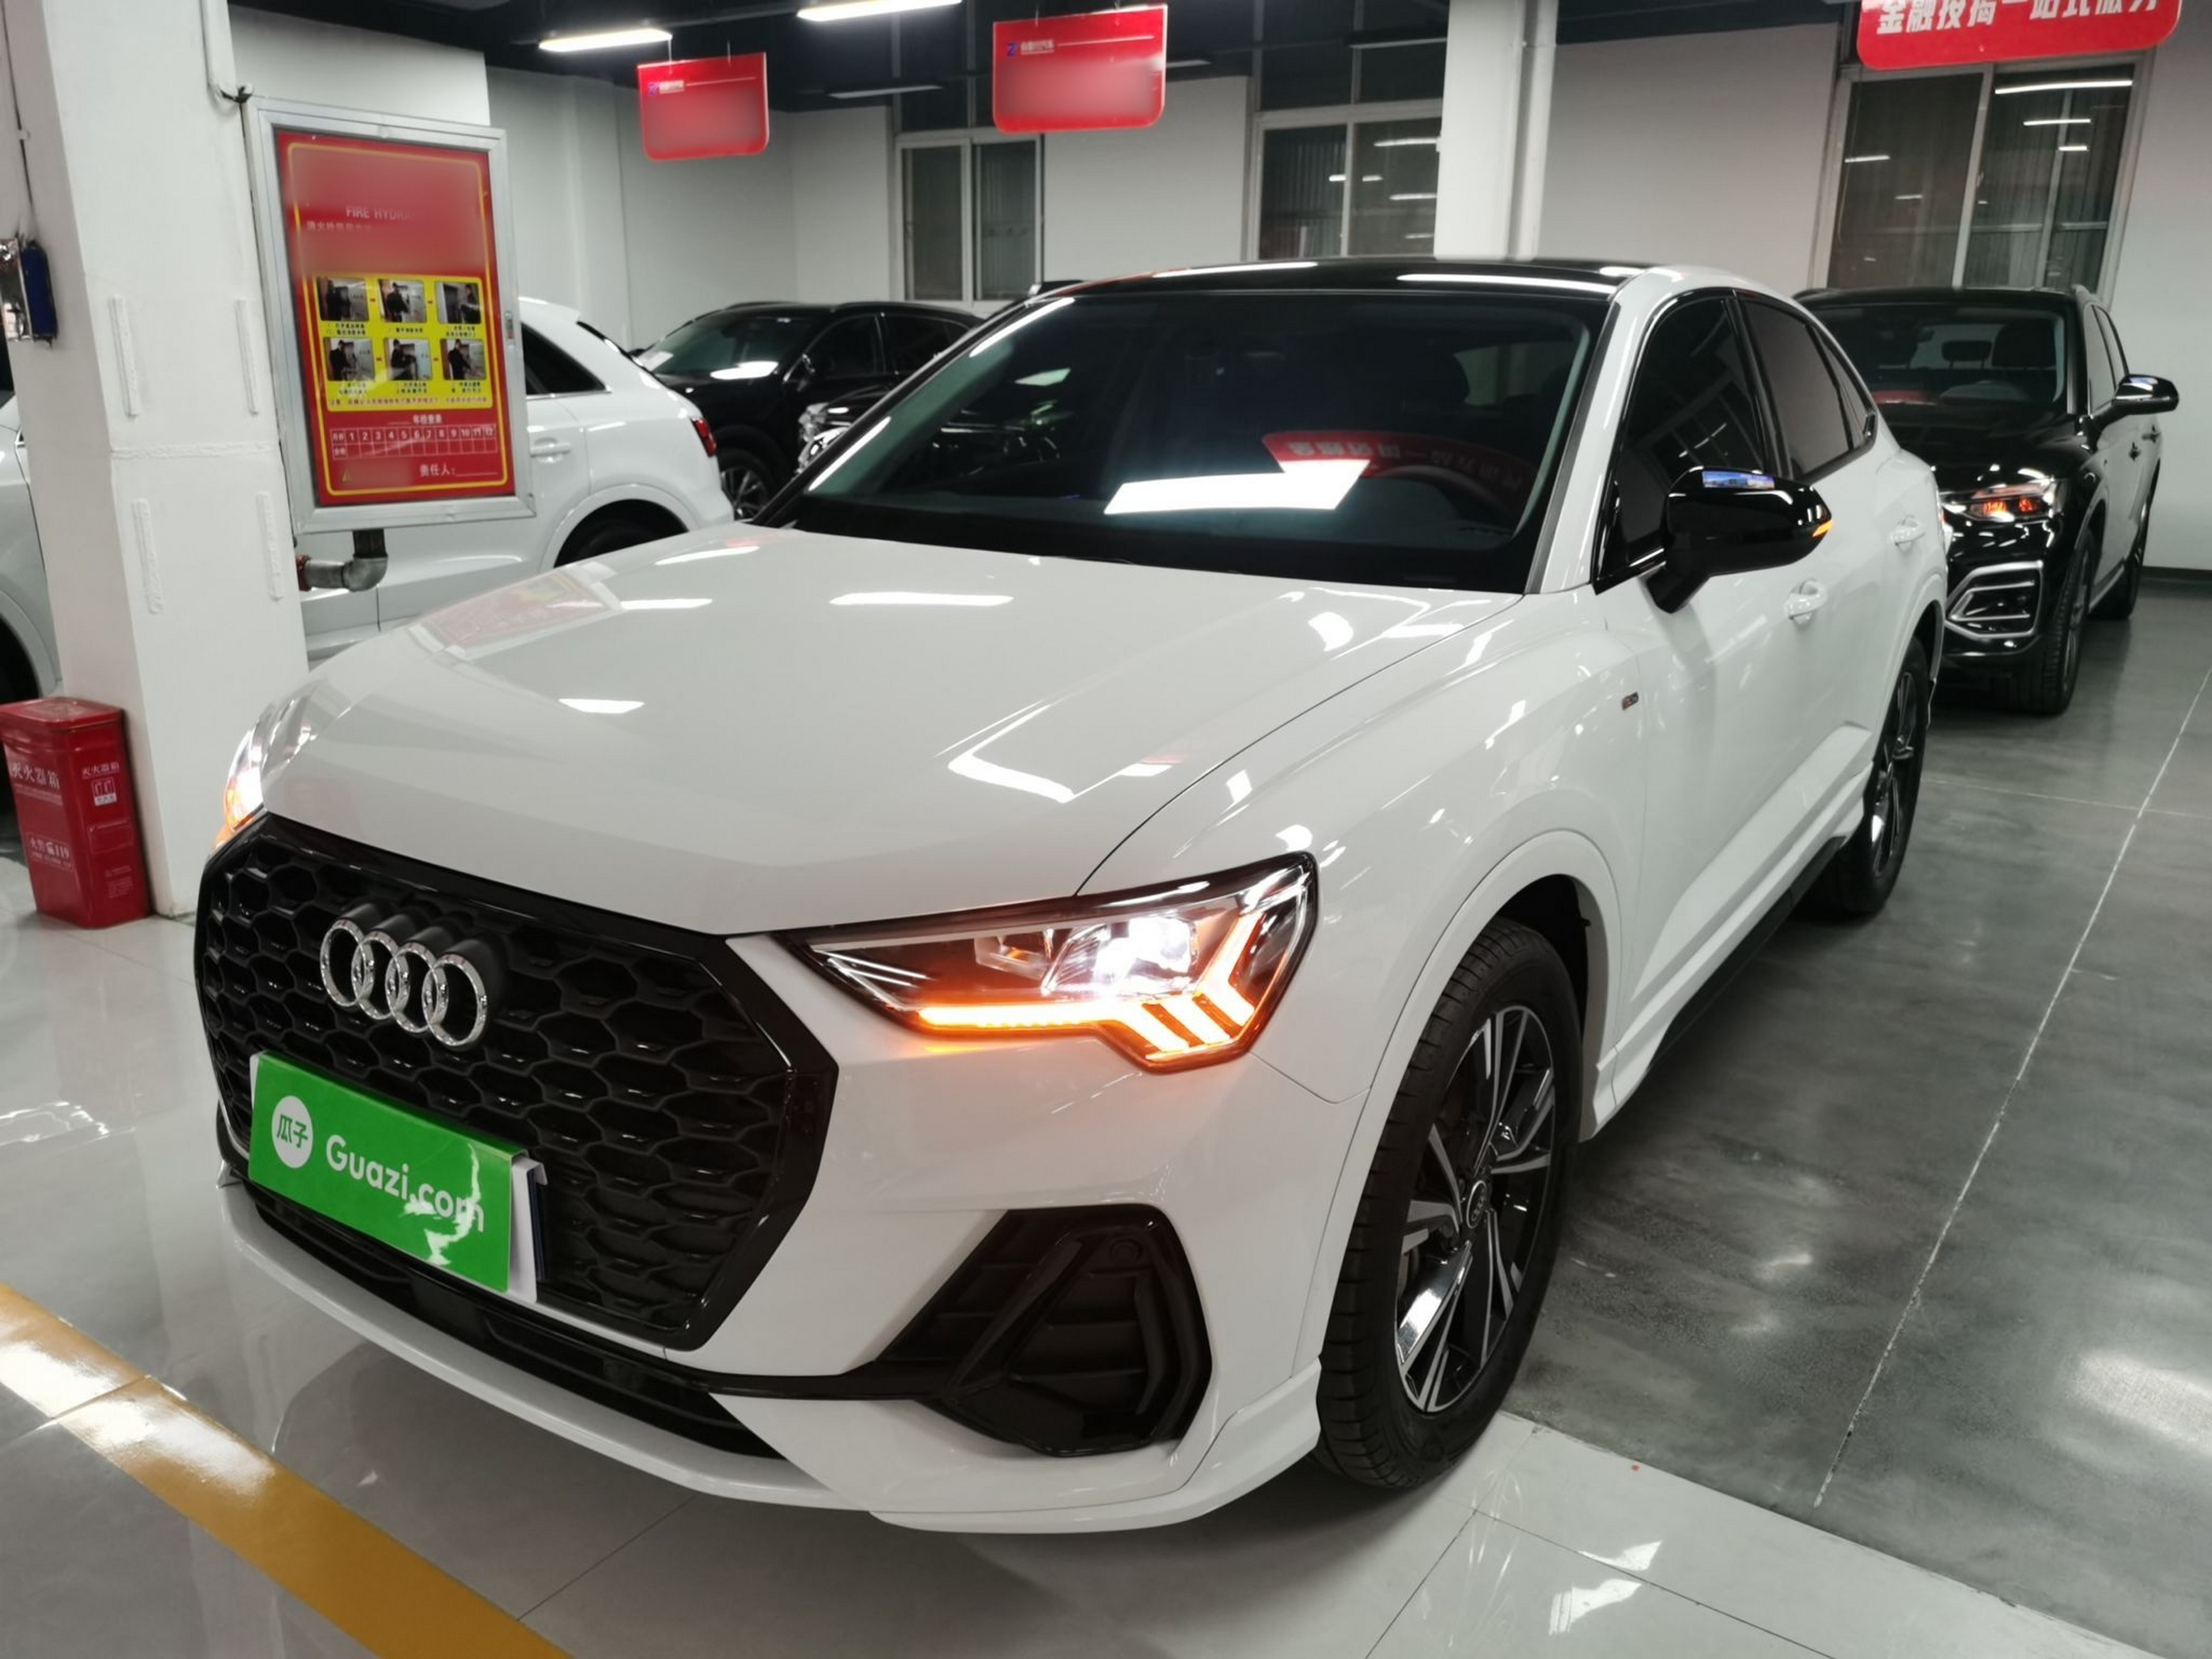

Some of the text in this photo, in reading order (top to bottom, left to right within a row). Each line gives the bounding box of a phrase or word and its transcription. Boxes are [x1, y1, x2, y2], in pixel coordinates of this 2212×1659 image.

[346, 206, 370, 219] FIRE
[461, 428, 470, 437] 10
[473, 427, 482, 436] 11
[484, 427, 493, 436] 12
[55, 844, 70, 859] 119
[276, 1114, 309, 1148] 瓜子
[325, 1134, 484, 1233] Guazi.com
